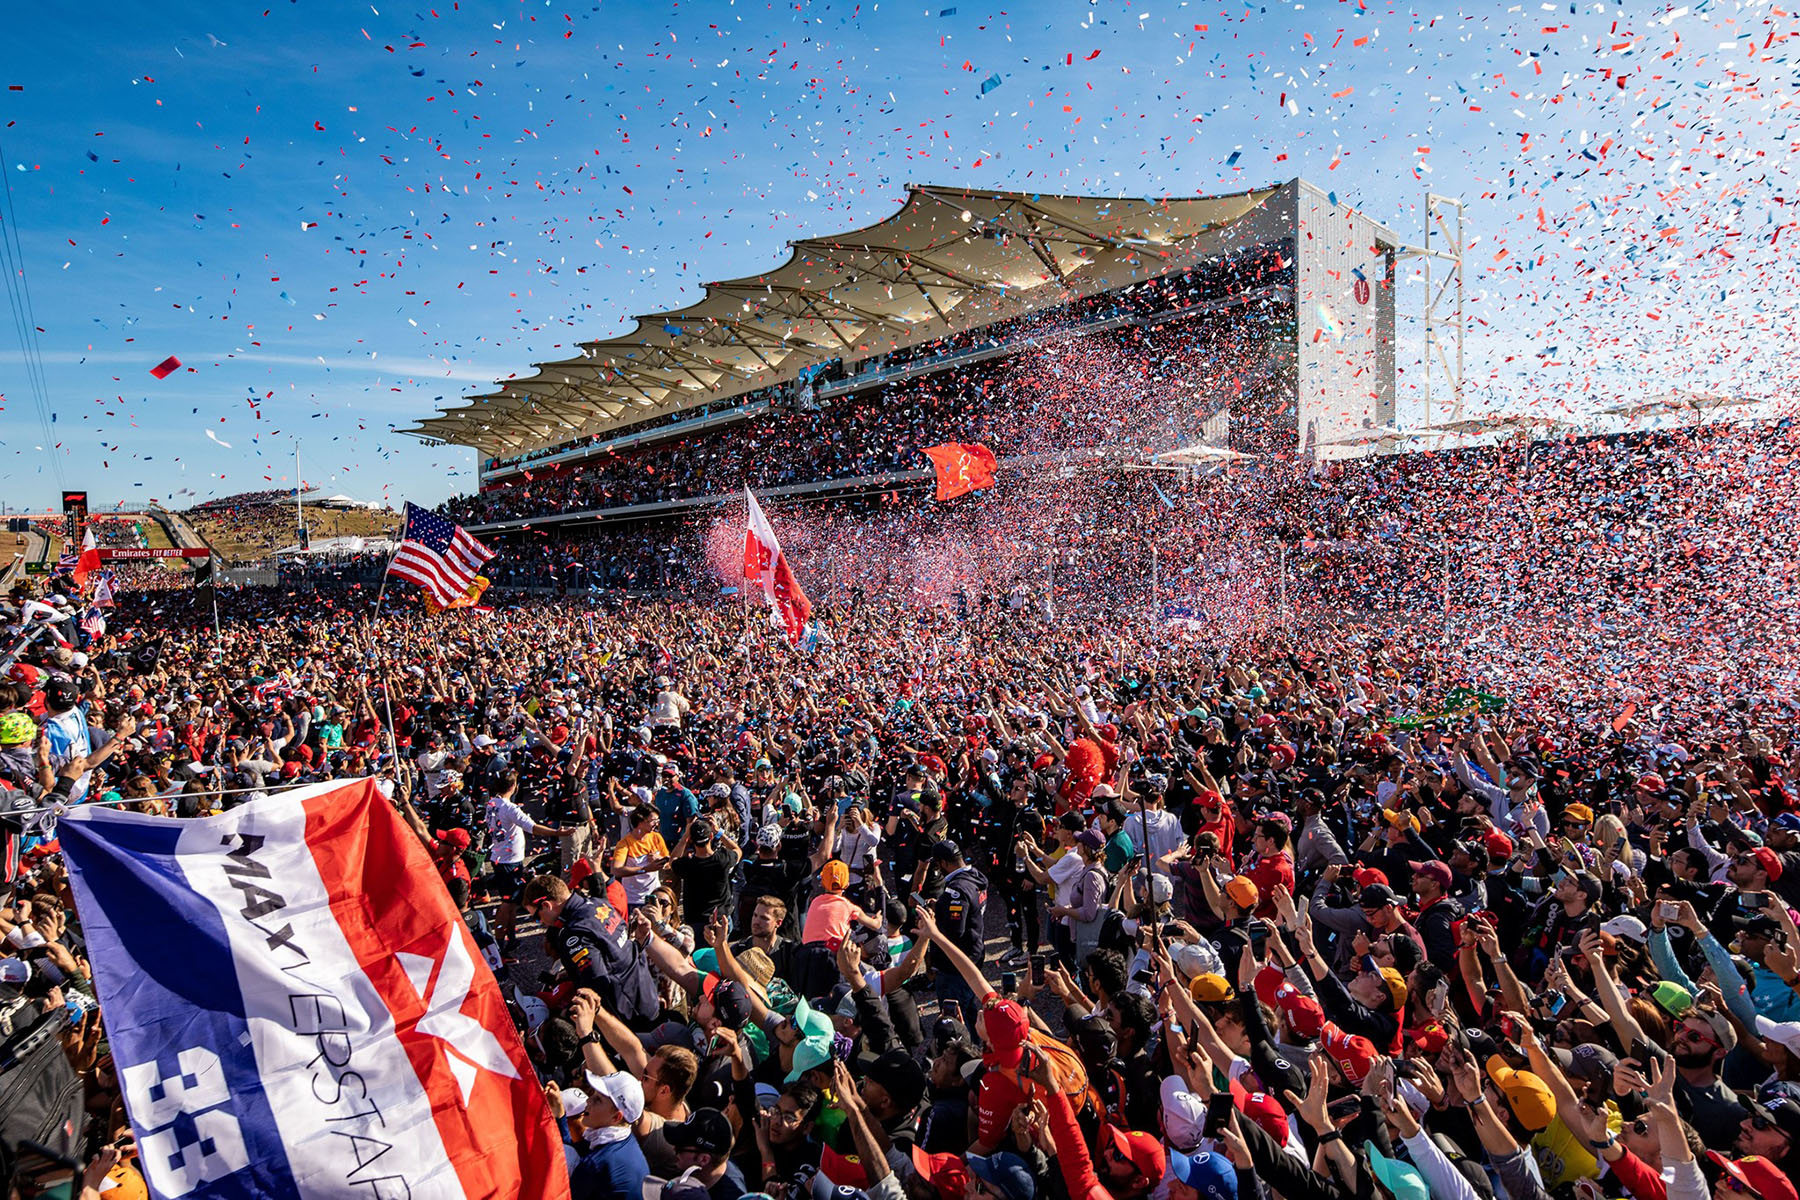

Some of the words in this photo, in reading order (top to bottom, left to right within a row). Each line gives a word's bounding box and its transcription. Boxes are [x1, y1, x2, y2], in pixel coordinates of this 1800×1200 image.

[112, 549, 150, 557] Emirates
[153, 549, 163, 557] FLY
[220, 833, 310, 960] MAX
[122, 1046, 250, 1200] 33
